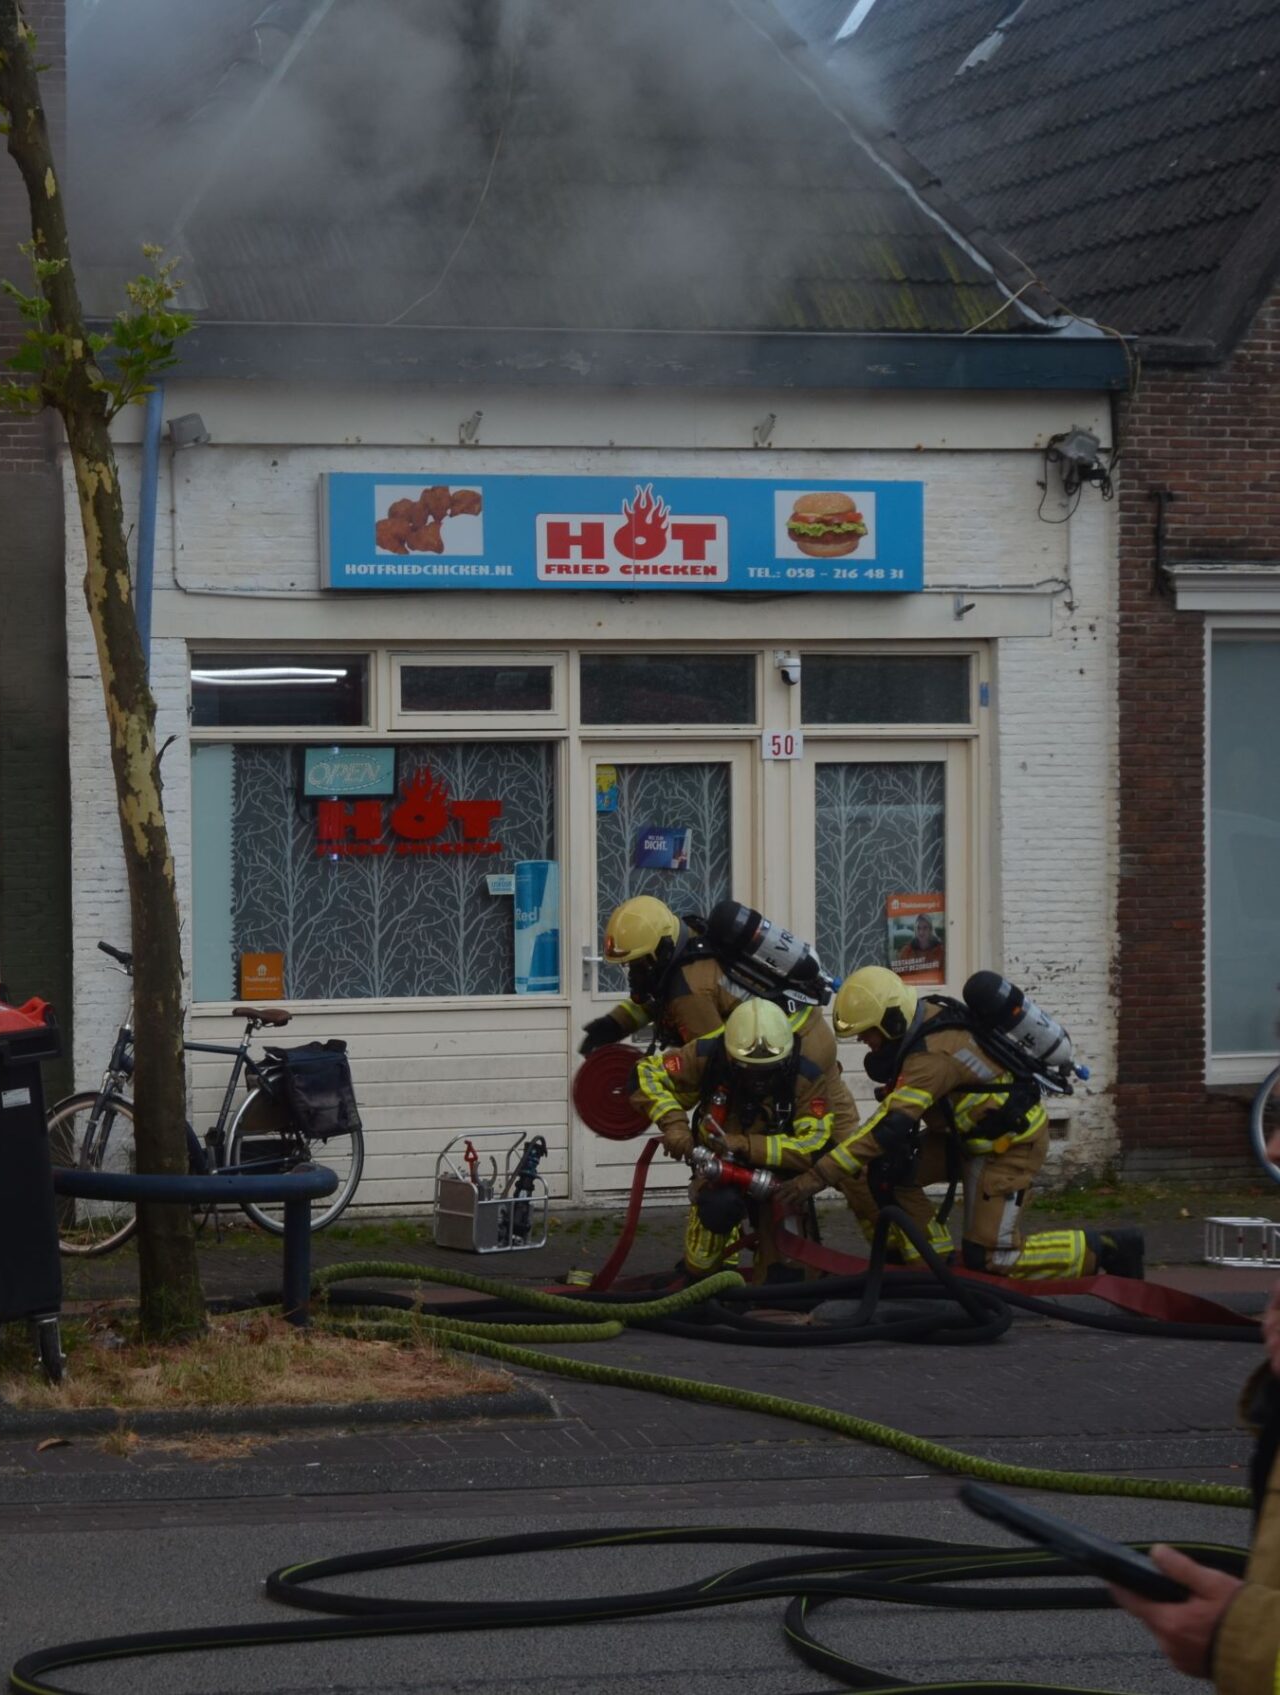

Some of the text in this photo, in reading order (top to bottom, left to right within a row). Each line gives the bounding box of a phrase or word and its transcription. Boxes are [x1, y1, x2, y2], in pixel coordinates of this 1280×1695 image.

[546, 488, 717, 561] HOT
[345, 563, 514, 576] HOTFRIEDCHICKEN.NL
[544, 563, 717, 576] FRIED CHICKEN
[747, 566, 781, 578] TEL.:
[786, 567, 816, 579] 058
[833, 568, 859, 579] 216
[863, 568, 886, 579] 48
[889, 568, 905, 579] 31
[771, 733, 794, 757] 50
[317, 767, 503, 840] HOT
